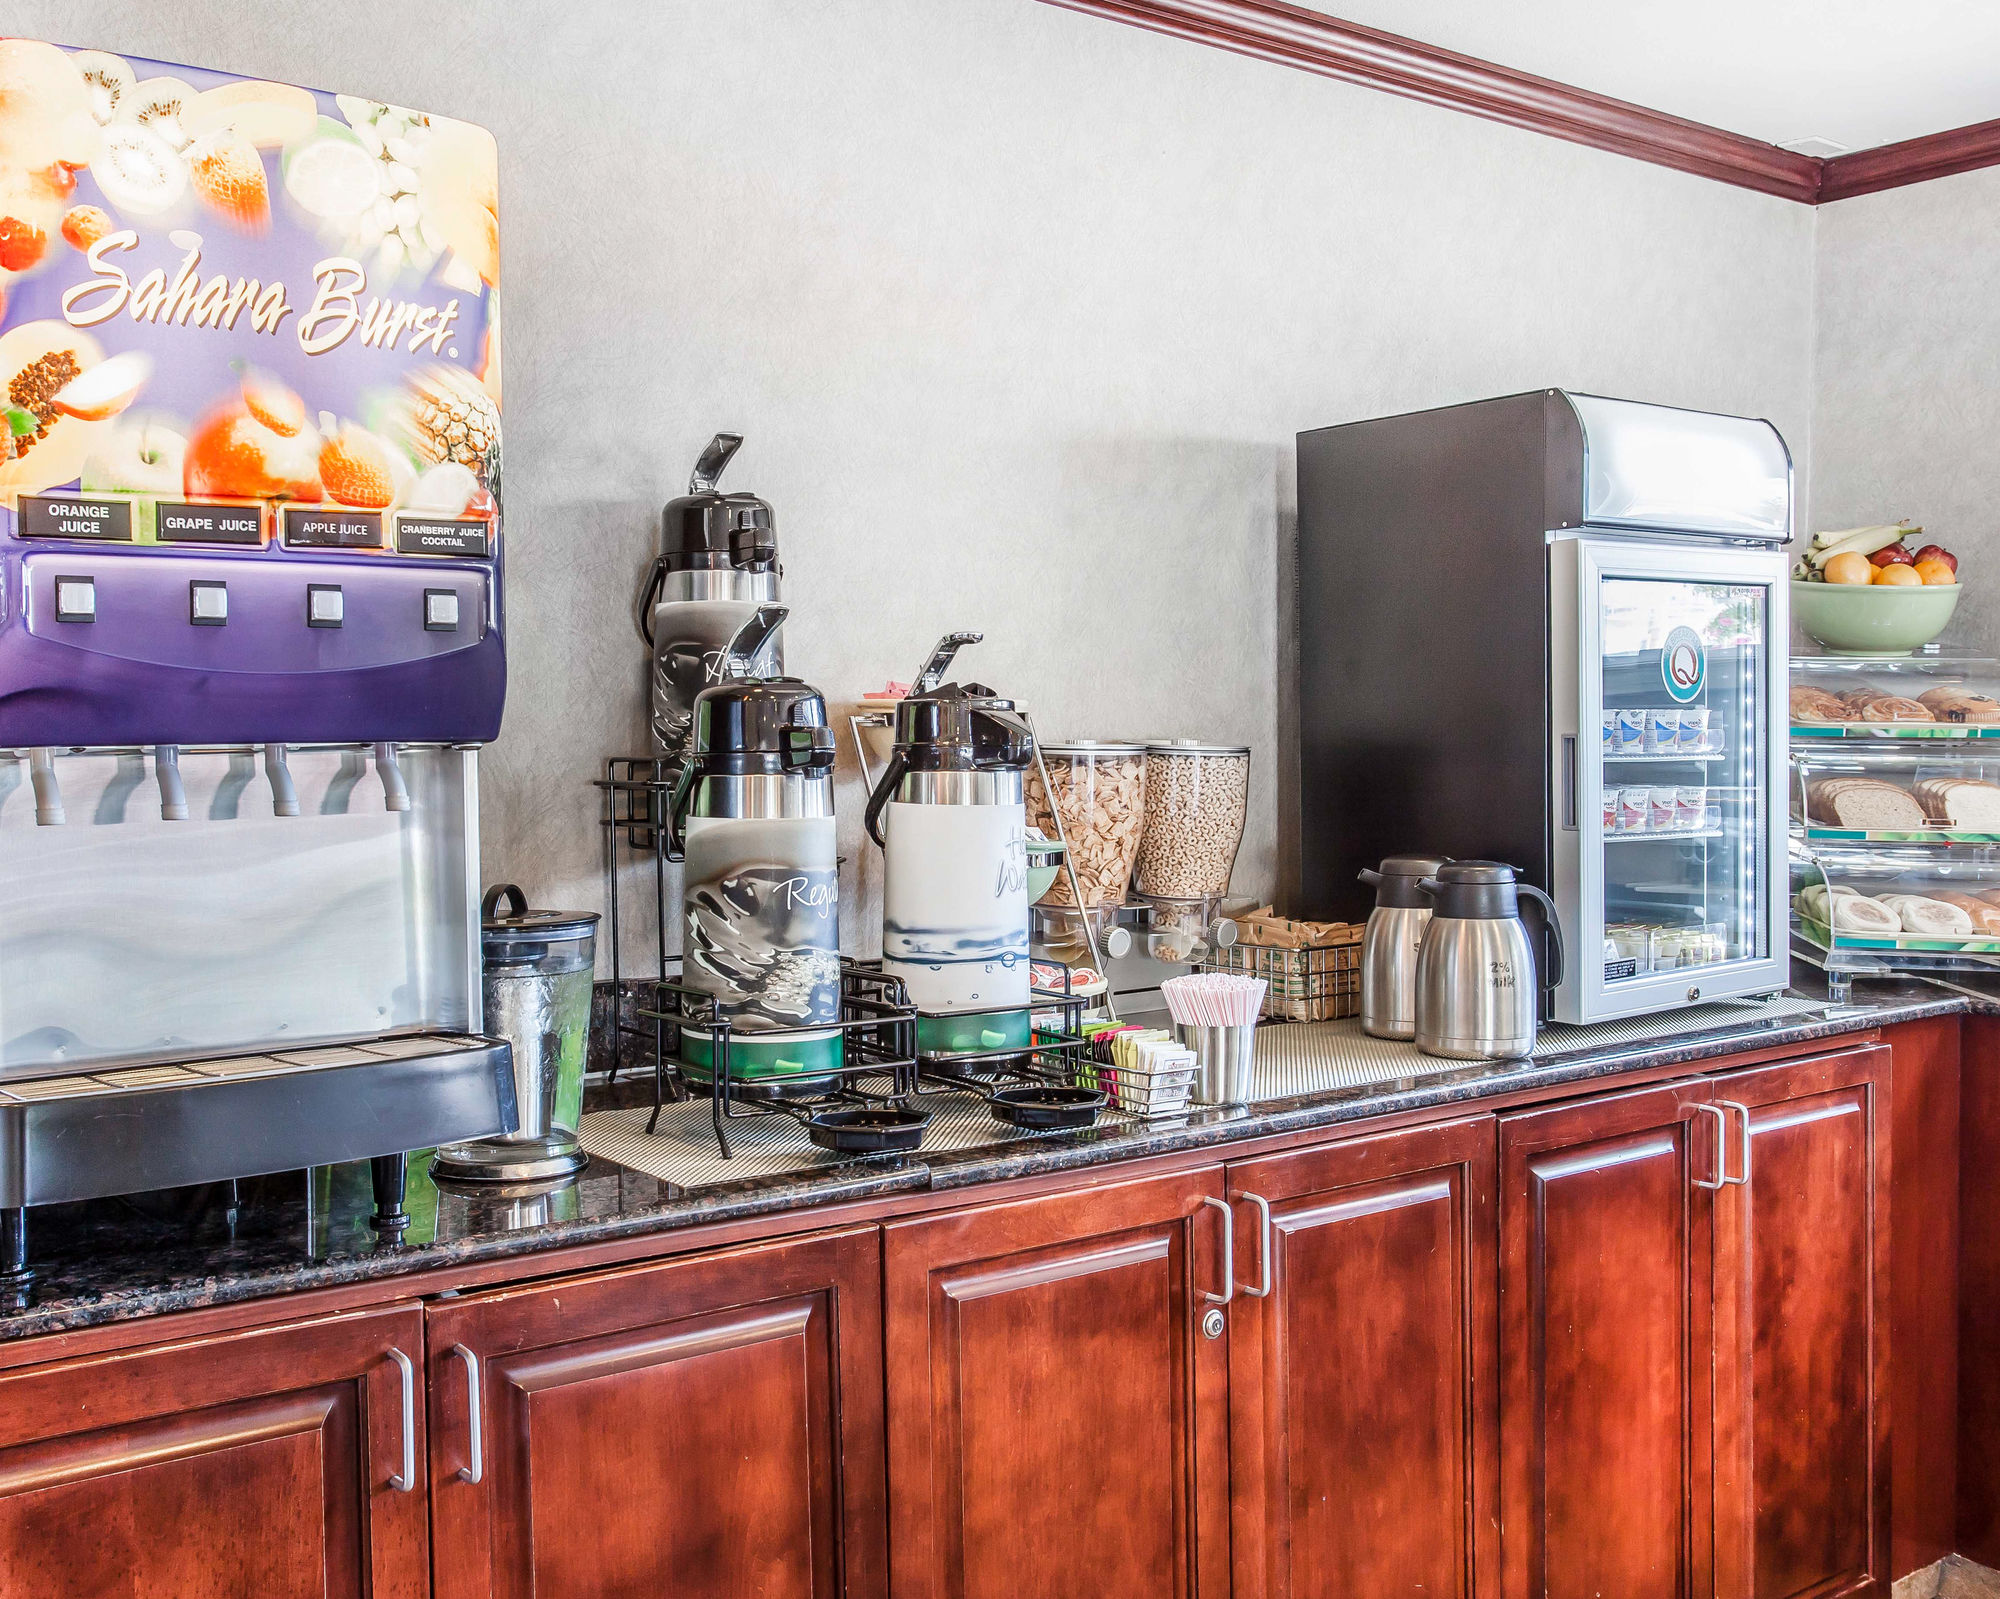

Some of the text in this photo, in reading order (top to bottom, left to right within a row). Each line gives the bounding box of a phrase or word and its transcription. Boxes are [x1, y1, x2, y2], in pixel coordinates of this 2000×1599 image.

[62, 230, 292, 335] Sahara
[48, 504, 110, 519] ORANGE
[58, 520, 101, 533] JUICE
[166, 516, 257, 531] GRAPE JUICE
[302, 522, 368, 535] APPLE JUICE
[401, 524, 484, 537] CRANBERRY JUICE
[421, 537, 465, 547] COCKTAIL
[1671, 642, 1700, 685] Q
[1490, 961, 1510, 973] 2%
